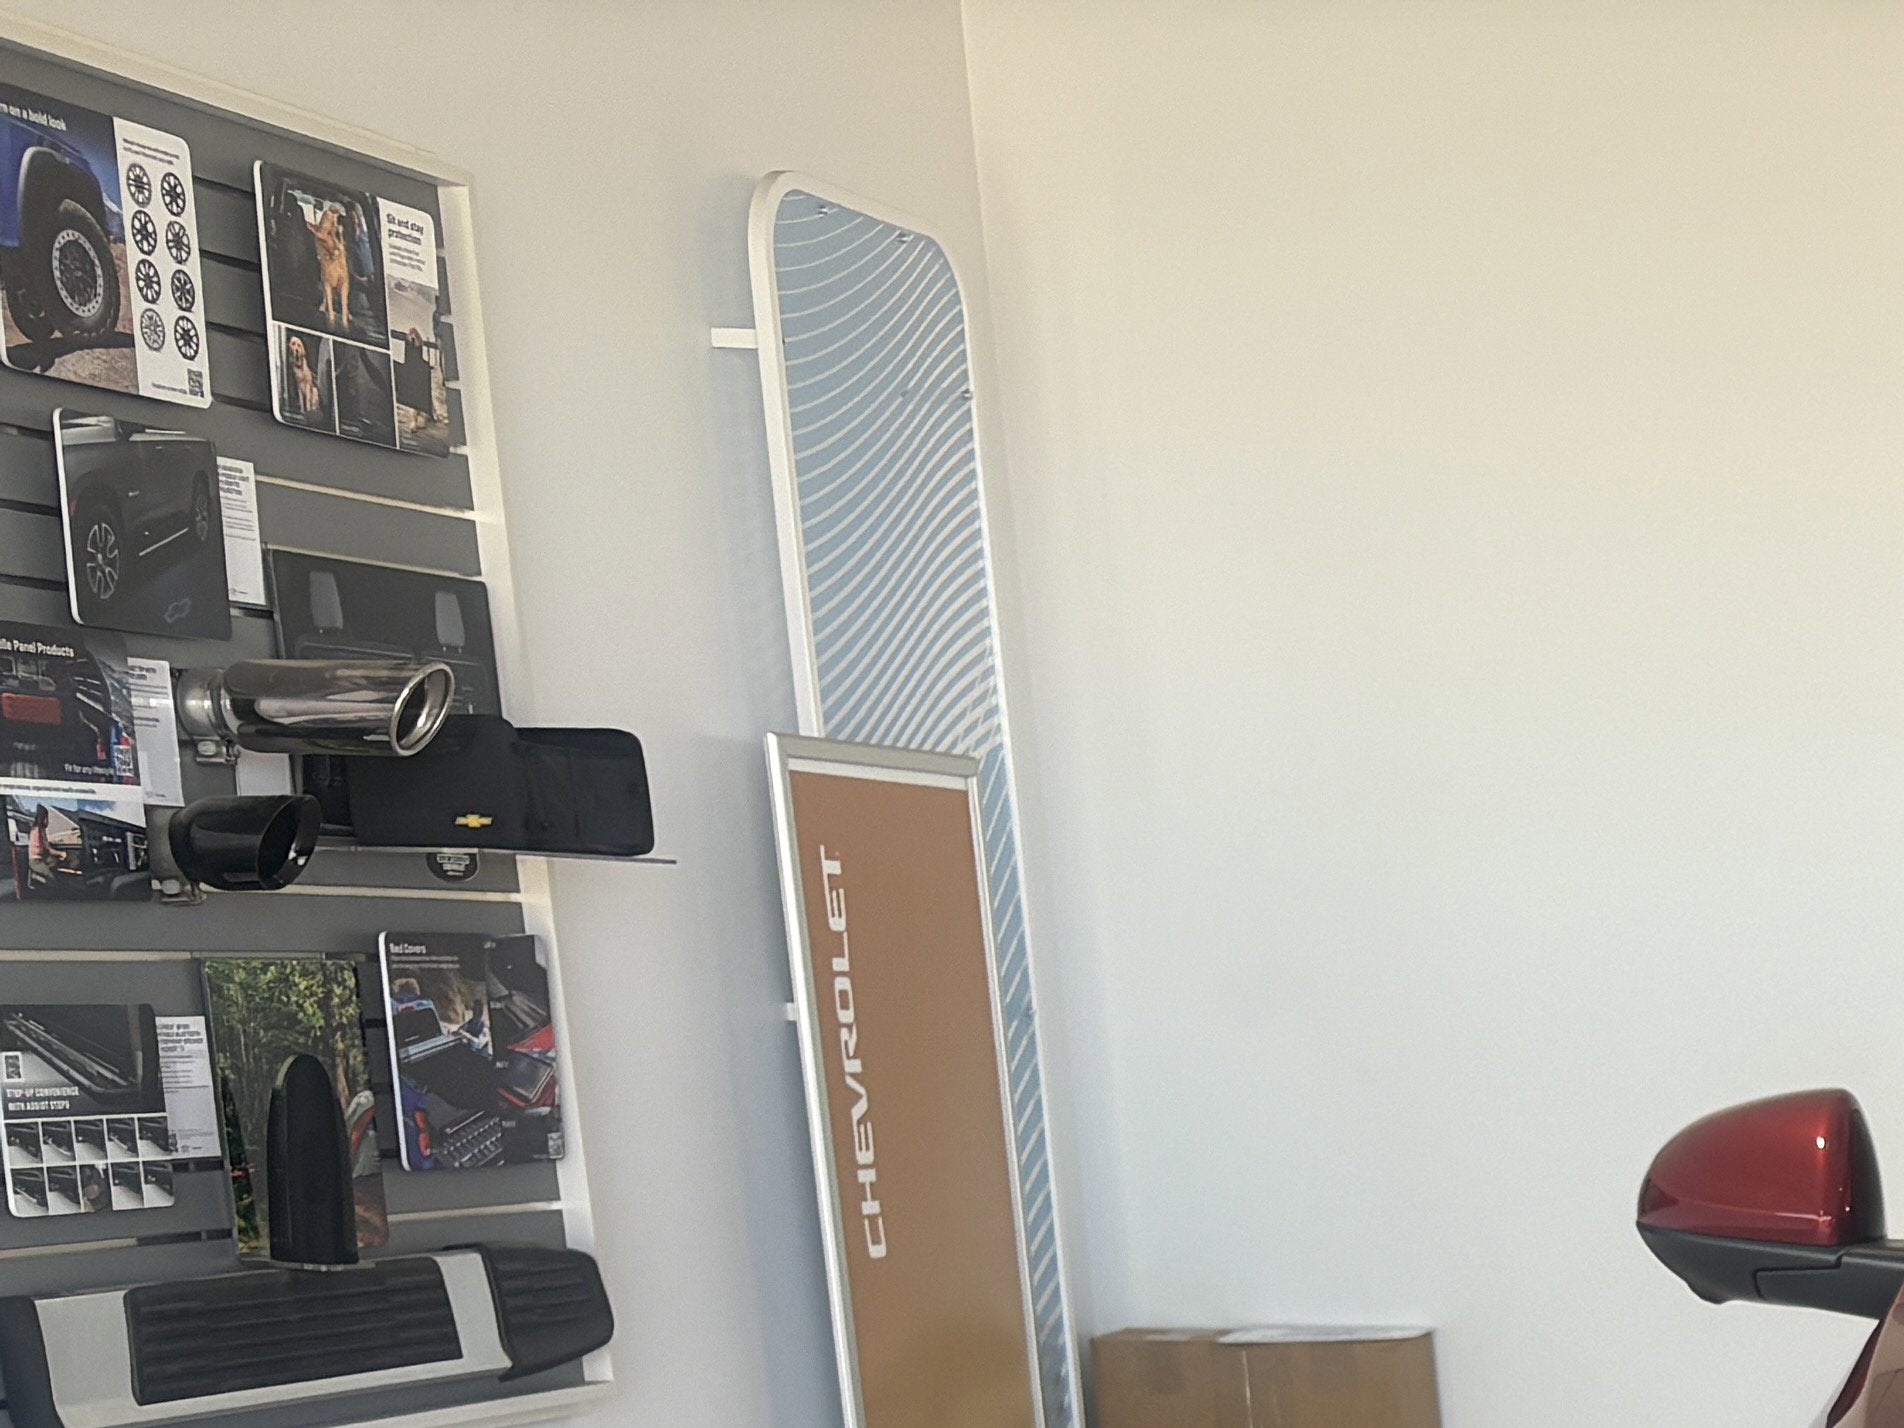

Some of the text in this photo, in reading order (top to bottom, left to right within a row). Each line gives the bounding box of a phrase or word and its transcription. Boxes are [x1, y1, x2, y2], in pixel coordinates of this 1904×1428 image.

[13, 639, 36, 653] Panel
[37, 642, 75, 658] Products
[820, 845, 887, 1259] CHEVROLET
